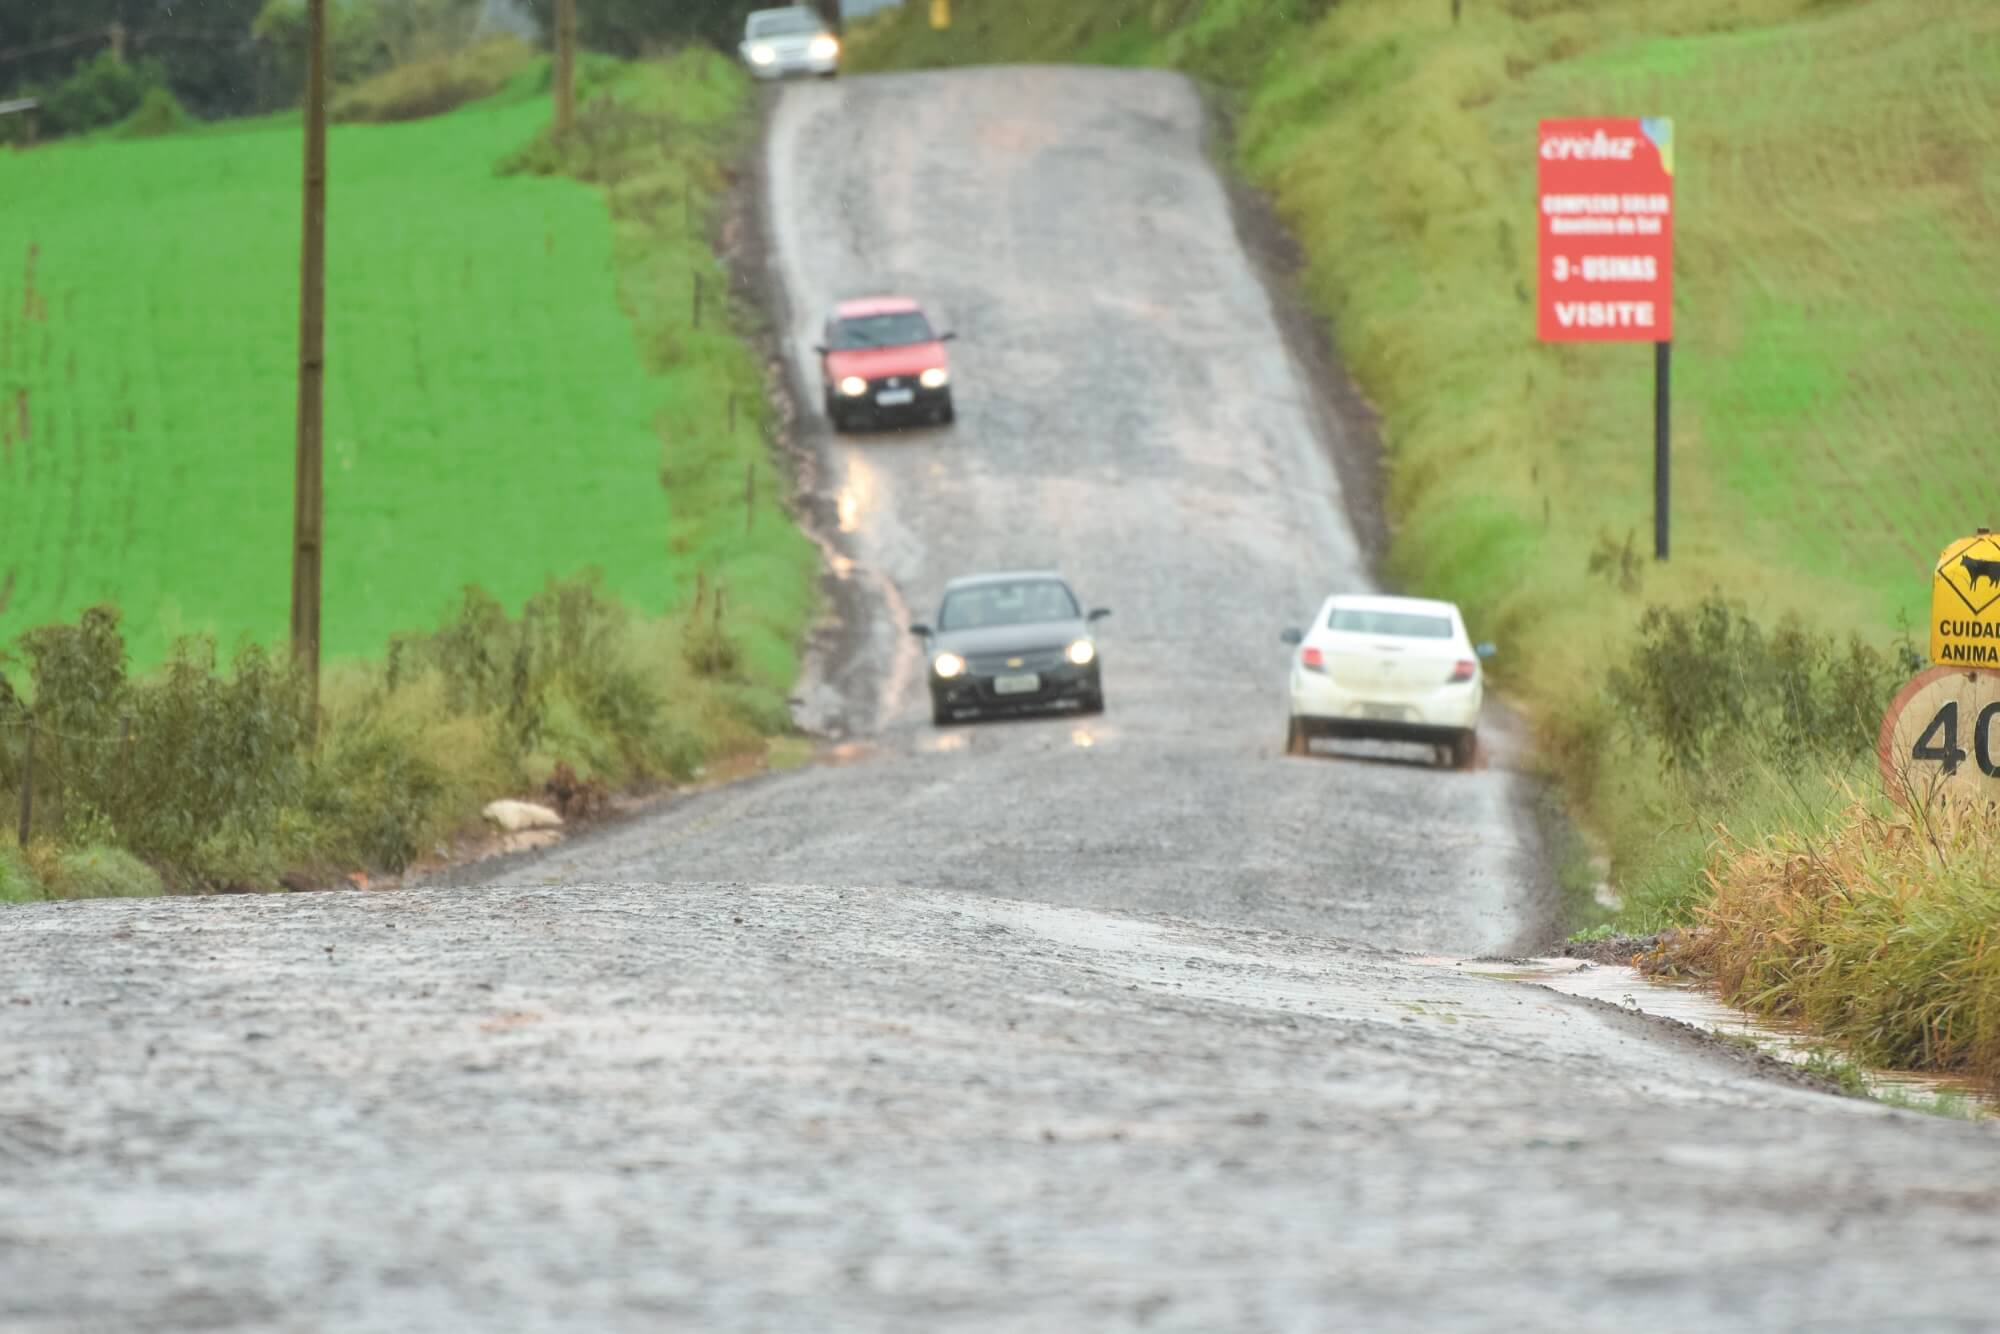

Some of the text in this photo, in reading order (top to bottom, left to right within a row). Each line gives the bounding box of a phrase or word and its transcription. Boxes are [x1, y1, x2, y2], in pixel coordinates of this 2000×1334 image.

[1553, 255, 1569, 281] 3
[1582, 255, 1657, 281] USINAS
[1554, 302, 1655, 327] VISITE
[1941, 643, 1998, 662] ANIMA
